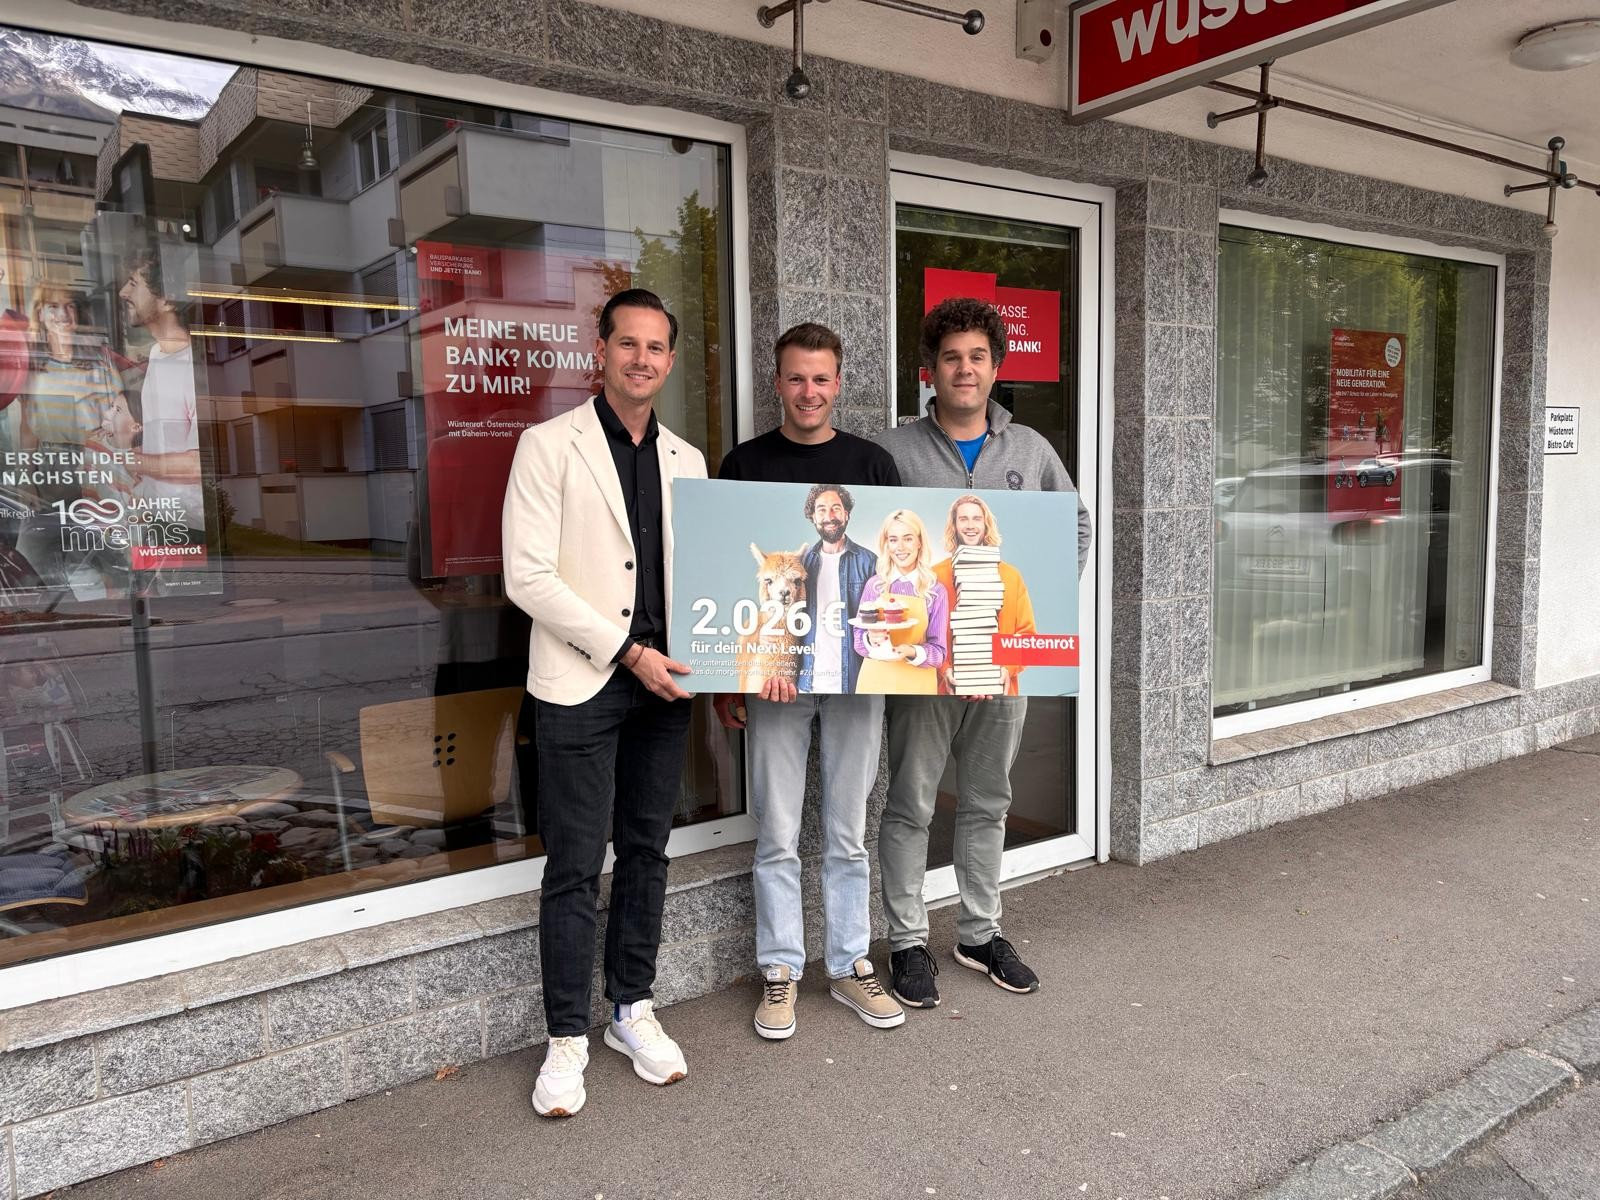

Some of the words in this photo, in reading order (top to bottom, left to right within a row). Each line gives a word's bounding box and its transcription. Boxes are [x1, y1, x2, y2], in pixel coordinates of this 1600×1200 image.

[444, 317, 517, 340] MEINE
[523, 322, 579, 343] NEUE
[1009, 340, 1042, 353] BANK!
[446, 346, 520, 368] BANK?
[1378, 370, 1390, 379] EINE
[445, 374, 476, 393] ZU
[483, 377, 531, 395] MIR!
[1336, 379, 1351, 388] NEUE
[1550, 412, 1574, 423] Parkplatz
[1547, 440, 1562, 449] Bistro
[4, 452, 84, 466] ERSTEN
[92, 451, 142, 465] IDEE.
[2, 468, 113, 486] NÄCHSTEN
[127, 497, 181, 510] JAHRE
[142, 510, 187, 523] GANZ
[60, 515, 190, 552] meins
[691, 598, 812, 638] 2.026
[822, 601, 846, 638] €
[691, 640, 711, 654] für
[714, 641, 742, 654] dein
[746, 642, 777, 655] Next
